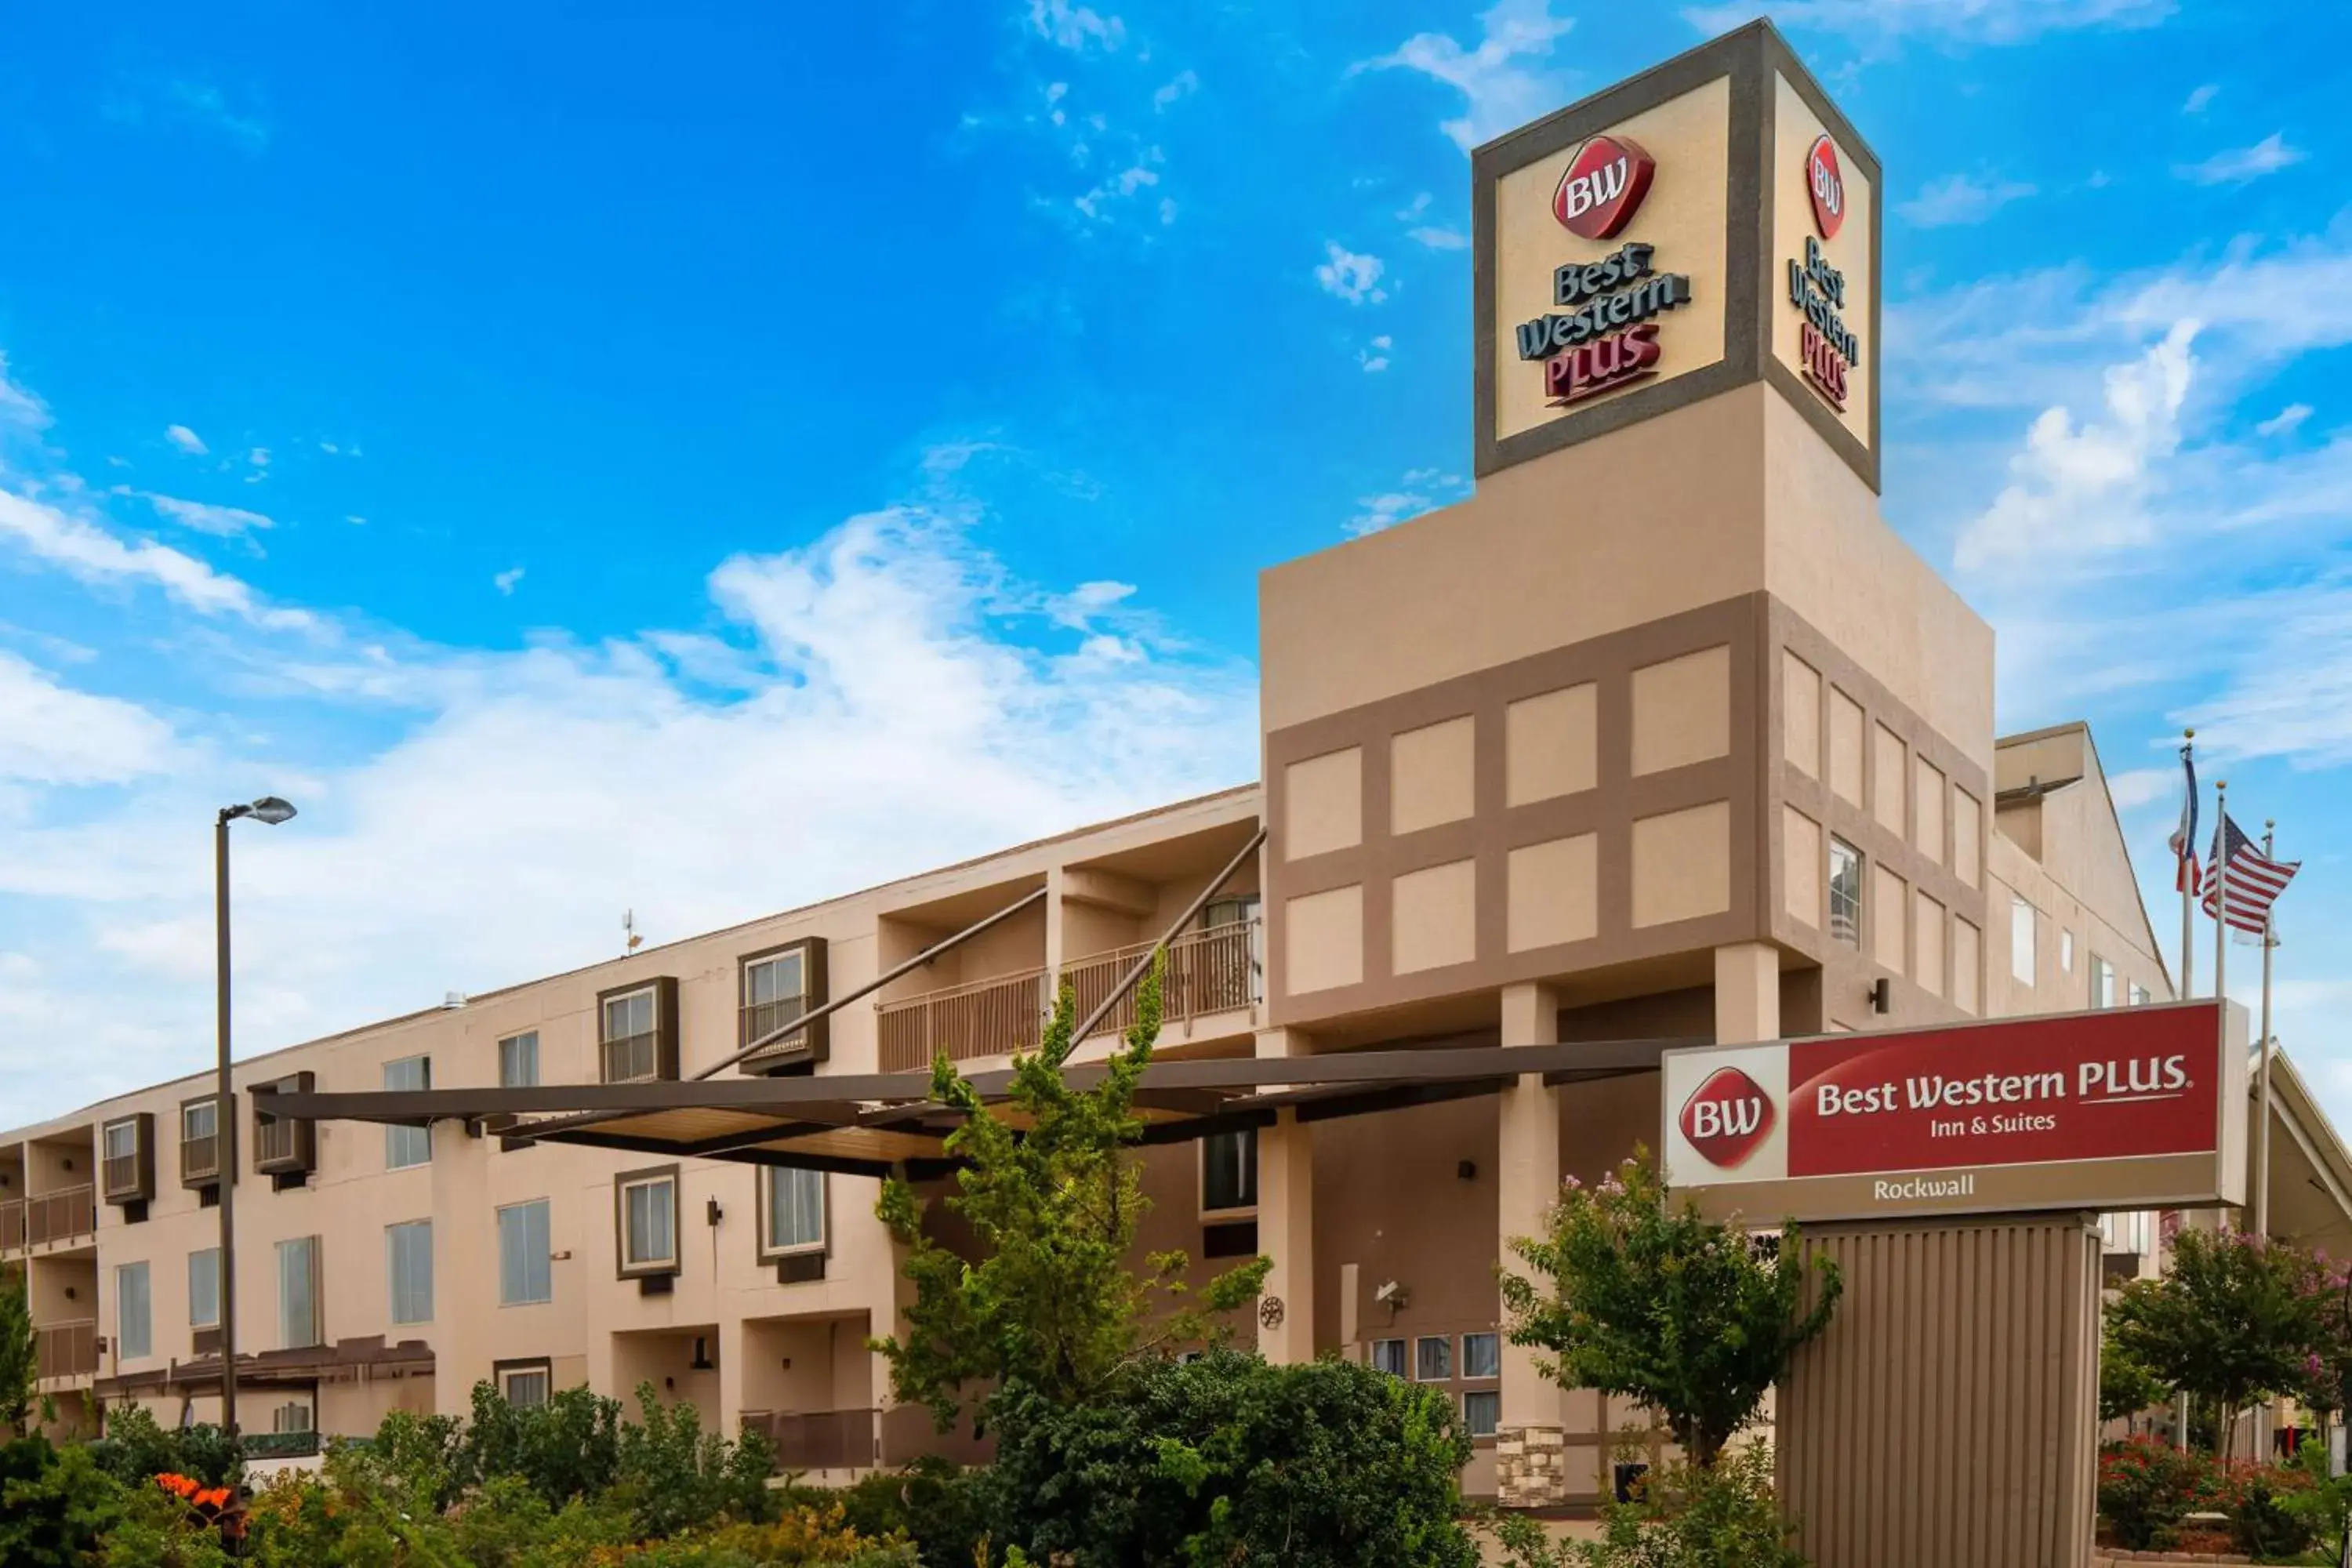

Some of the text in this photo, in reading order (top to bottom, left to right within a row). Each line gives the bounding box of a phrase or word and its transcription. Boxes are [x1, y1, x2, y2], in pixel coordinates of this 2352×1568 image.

[1566, 158, 1627, 219] BW
[1813, 157, 1840, 215] BW
[1554, 242, 1653, 306] Best
[1806, 237, 1845, 308] Best
[1515, 273, 1690, 361] Western
[1788, 259, 1858, 366] Western
[1545, 324, 1660, 397] PLUS
[1802, 322, 1848, 401] PLUS
[1817, 1055, 2186, 1116] Best Western PLUS
[1693, 1097, 1762, 1138] BW
[1931, 1113, 2056, 1138] Inn & Suites
[1875, 1175, 1973, 1200] Rockwall
